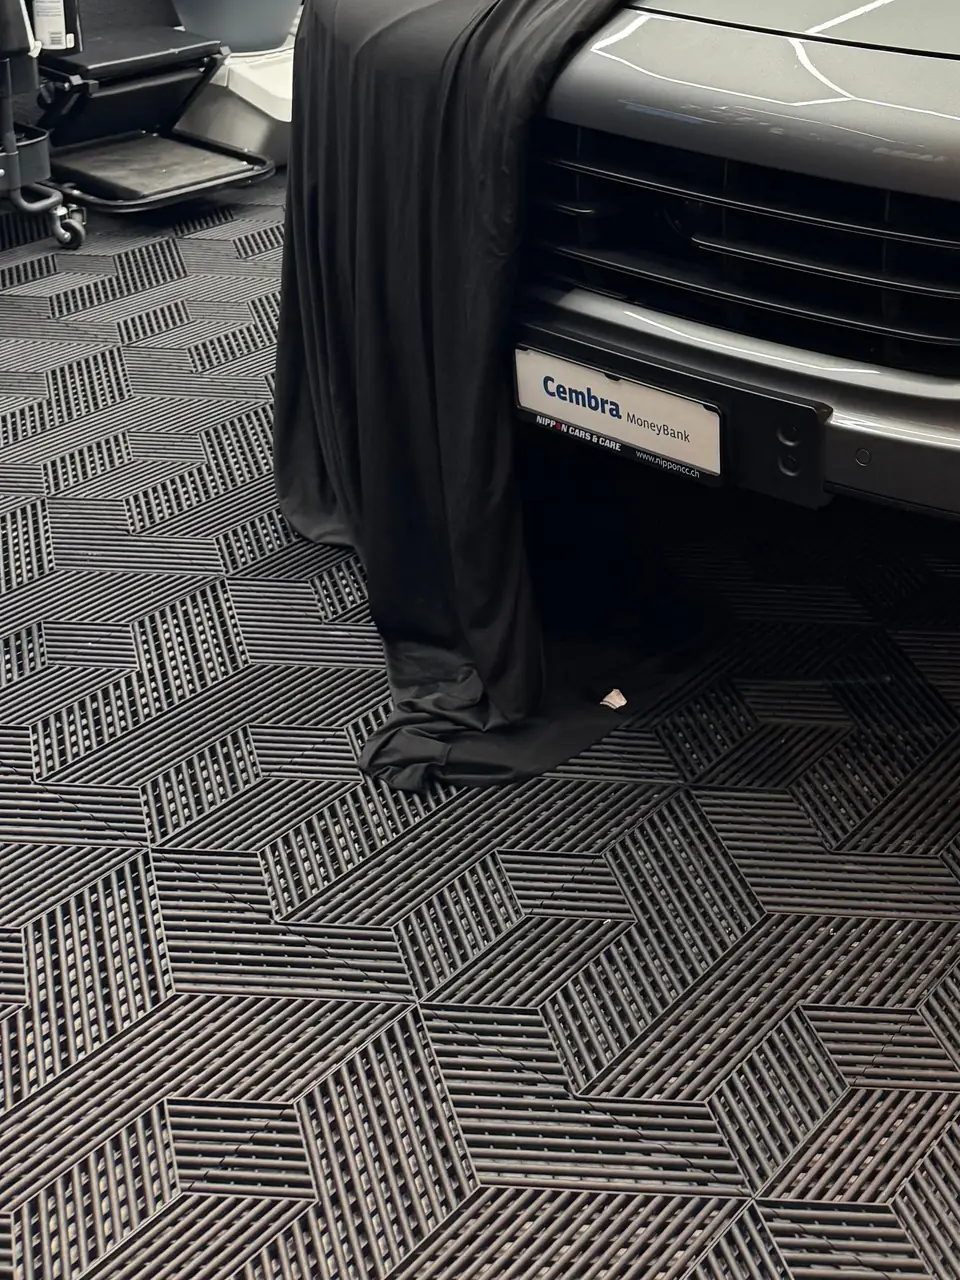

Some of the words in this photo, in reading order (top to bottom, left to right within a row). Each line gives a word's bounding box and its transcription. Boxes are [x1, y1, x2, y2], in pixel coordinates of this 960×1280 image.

[542, 375, 623, 420] Cembra
[626, 411, 691, 443] MoneyBank
[536, 415, 568, 433] NIPPON
[568, 426, 591, 441] CARS
[591, 434, 599, 443] &
[599, 436, 622, 452] CARE
[635, 450, 701, 479] www.nipponcc.ch
